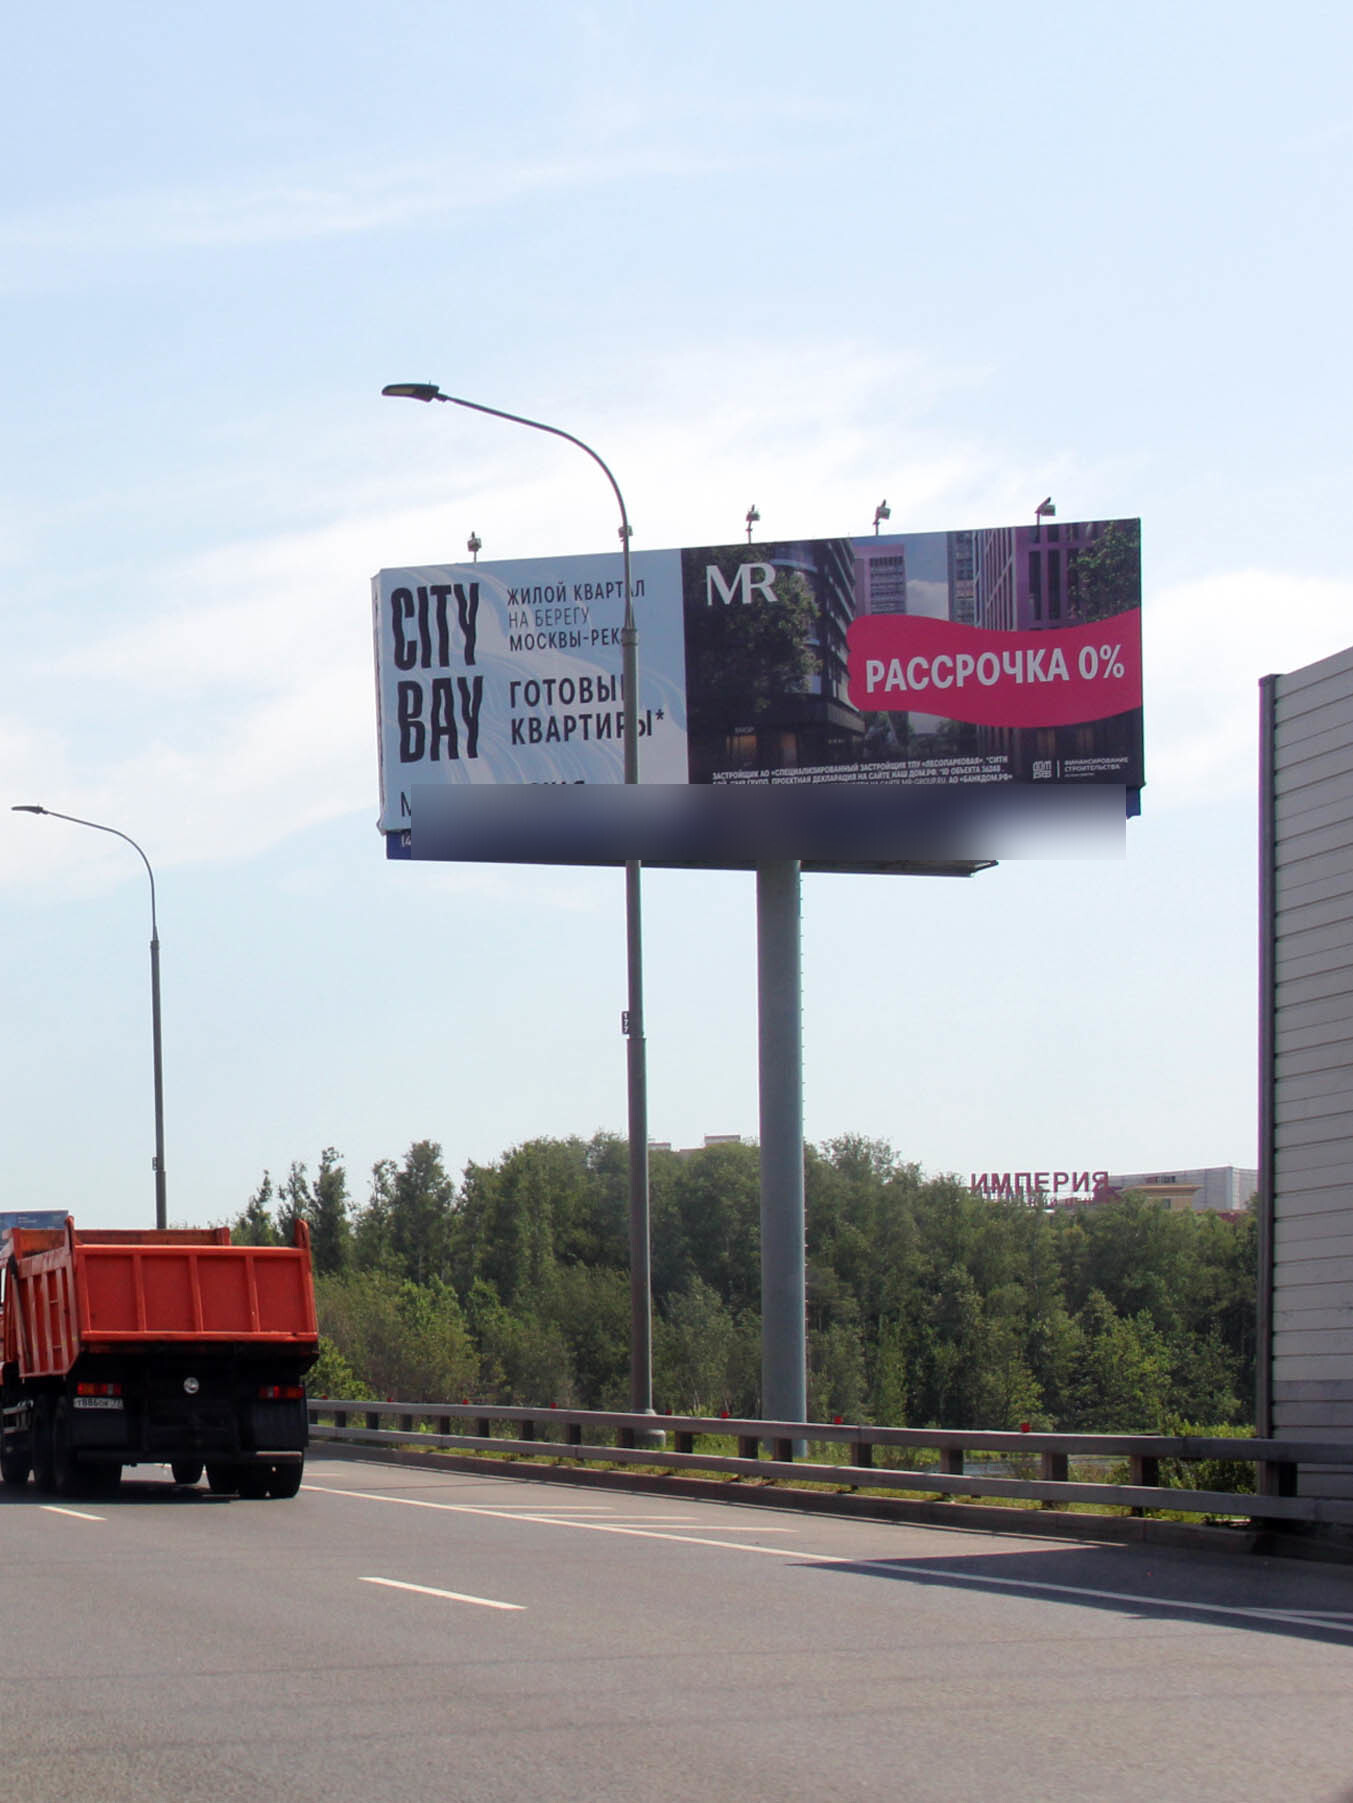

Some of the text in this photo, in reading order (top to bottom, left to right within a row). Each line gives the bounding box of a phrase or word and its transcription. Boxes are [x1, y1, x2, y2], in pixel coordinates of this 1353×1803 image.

[507, 579, 645, 605] ЖИЛОЙ КВАРТЛ
[706, 562, 778, 607] MR
[391, 582, 479, 671] CITY
[509, 606, 589, 628] НА БЕРЕГУ
[509, 627, 625, 652] МОСКВЫ-РЕК
[866, 643, 1125, 693] РАССРОЧКА 0%
[510, 674, 625, 708] ГОТОВЫ
[398, 675, 483, 763] BAY
[971, 1171, 1109, 1194] ИМПЕРИЯ
